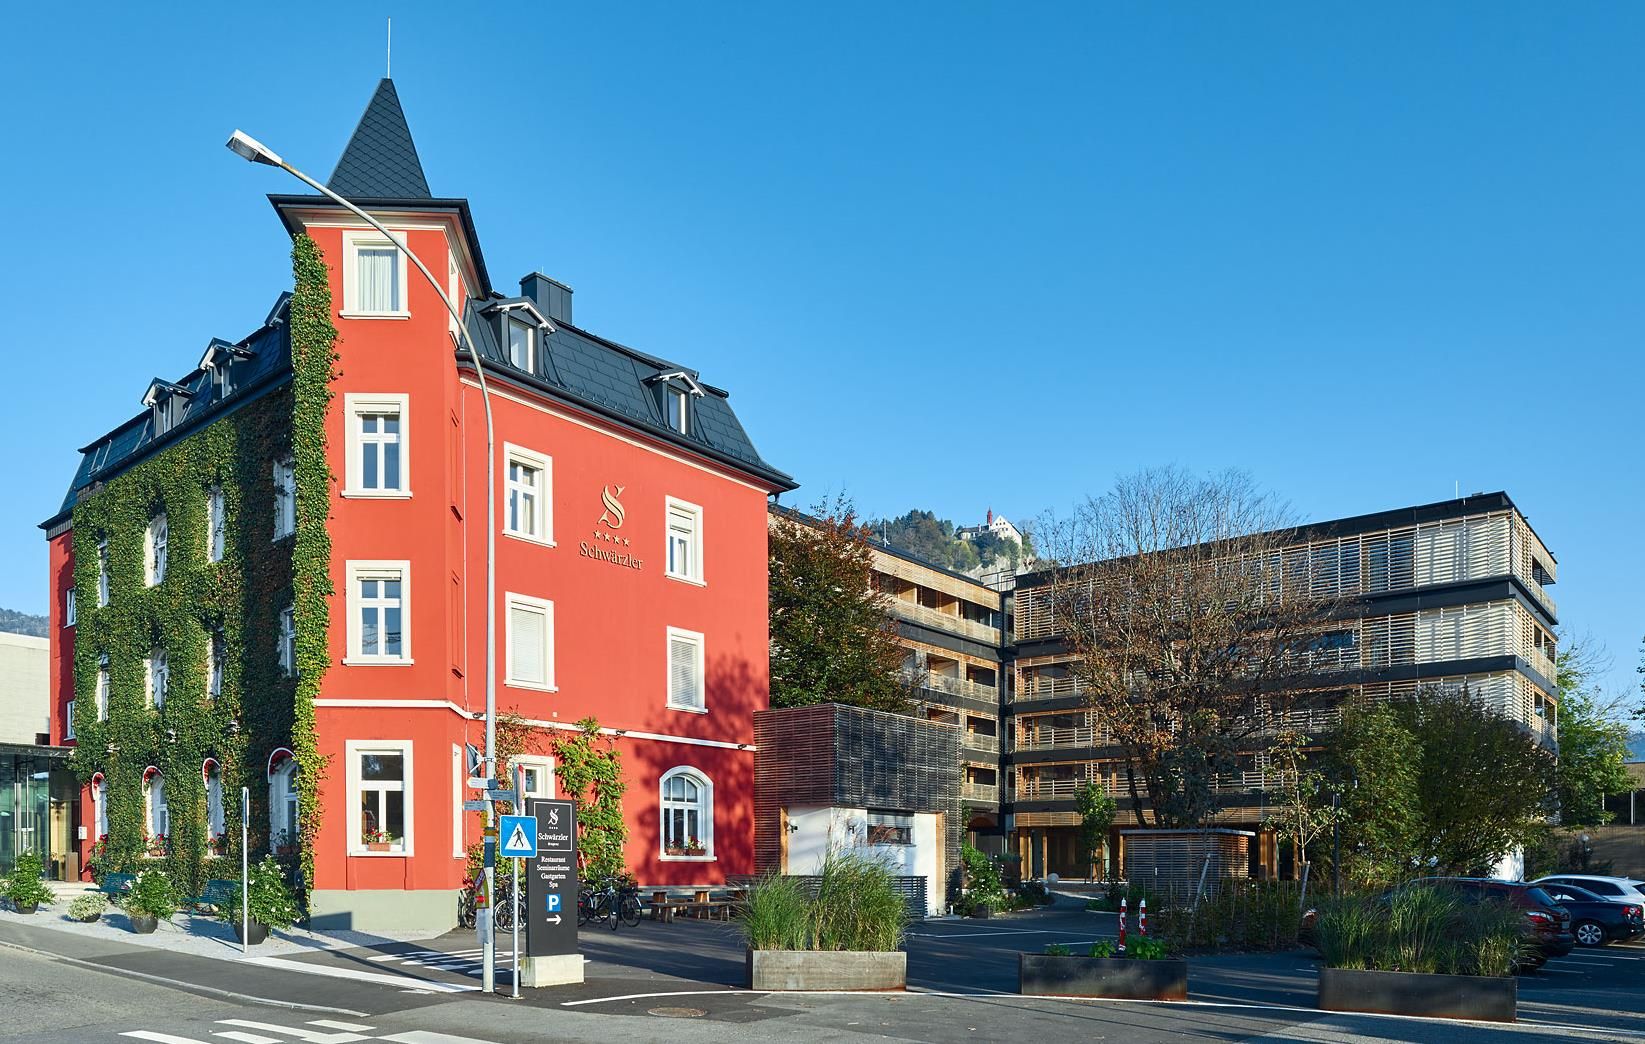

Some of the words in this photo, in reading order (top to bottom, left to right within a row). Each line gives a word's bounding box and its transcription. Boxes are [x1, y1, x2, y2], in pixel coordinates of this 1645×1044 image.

[579, 540, 643, 570] Schwärzler
[537, 832, 569, 841] Schwärzler
[540, 872, 567, 881] Gastgarten
[548, 881, 559, 889] Spa
[548, 894, 560, 911] P
